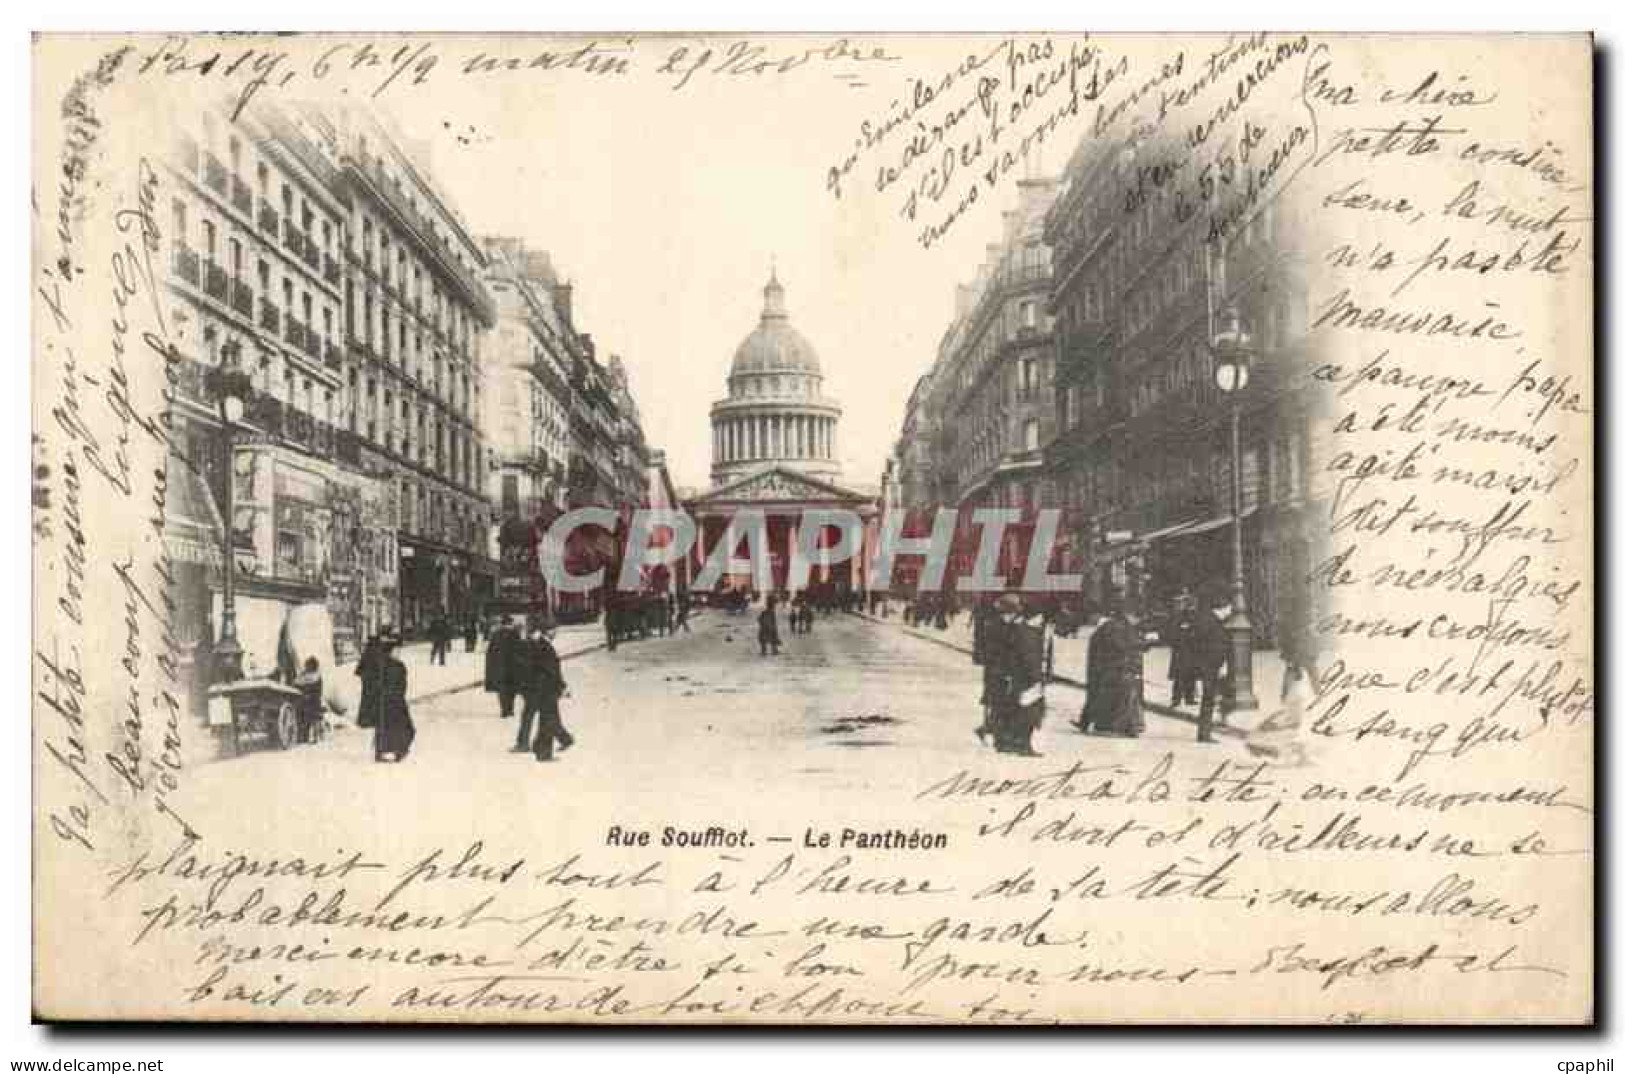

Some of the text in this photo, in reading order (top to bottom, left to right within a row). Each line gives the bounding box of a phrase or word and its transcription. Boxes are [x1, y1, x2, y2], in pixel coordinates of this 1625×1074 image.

[462, 40, 631, 74] matin
[1003, 38, 1054, 92] pas
[1313, 115, 1467, 167] petite
[1443, 180, 1478, 218] la
[1390, 237, 1501, 298] pas
[1337, 349, 1497, 397] pauvre
[1490, 358, 1594, 426] papa
[1437, 411, 1560, 455] moins
[1315, 613, 1424, 640] nous
[105, 552, 172, 798] beaucoup
[1306, 660, 1400, 710] que
[38, 645, 110, 806] petite
[1311, 695, 1350, 737] le
[1126, 751, 1172, 803] la
[1396, 783, 1588, 812] moment
[978, 801, 1036, 837] il
[1031, 812, 1148, 848] dort
[1146, 817, 1202, 849] et
[1431, 834, 1502, 857] ne
[376, 840, 526, 912] plus
[535, 855, 664, 889] tout
[694, 854, 744, 892] à
[972, 867, 1037, 899] de
[132, 886, 495, 946] probablement
[516, 899, 790, 949] prendre
[802, 916, 914, 940] une
[347, 945, 514, 968] encore
[900, 953, 1041, 996] pour
